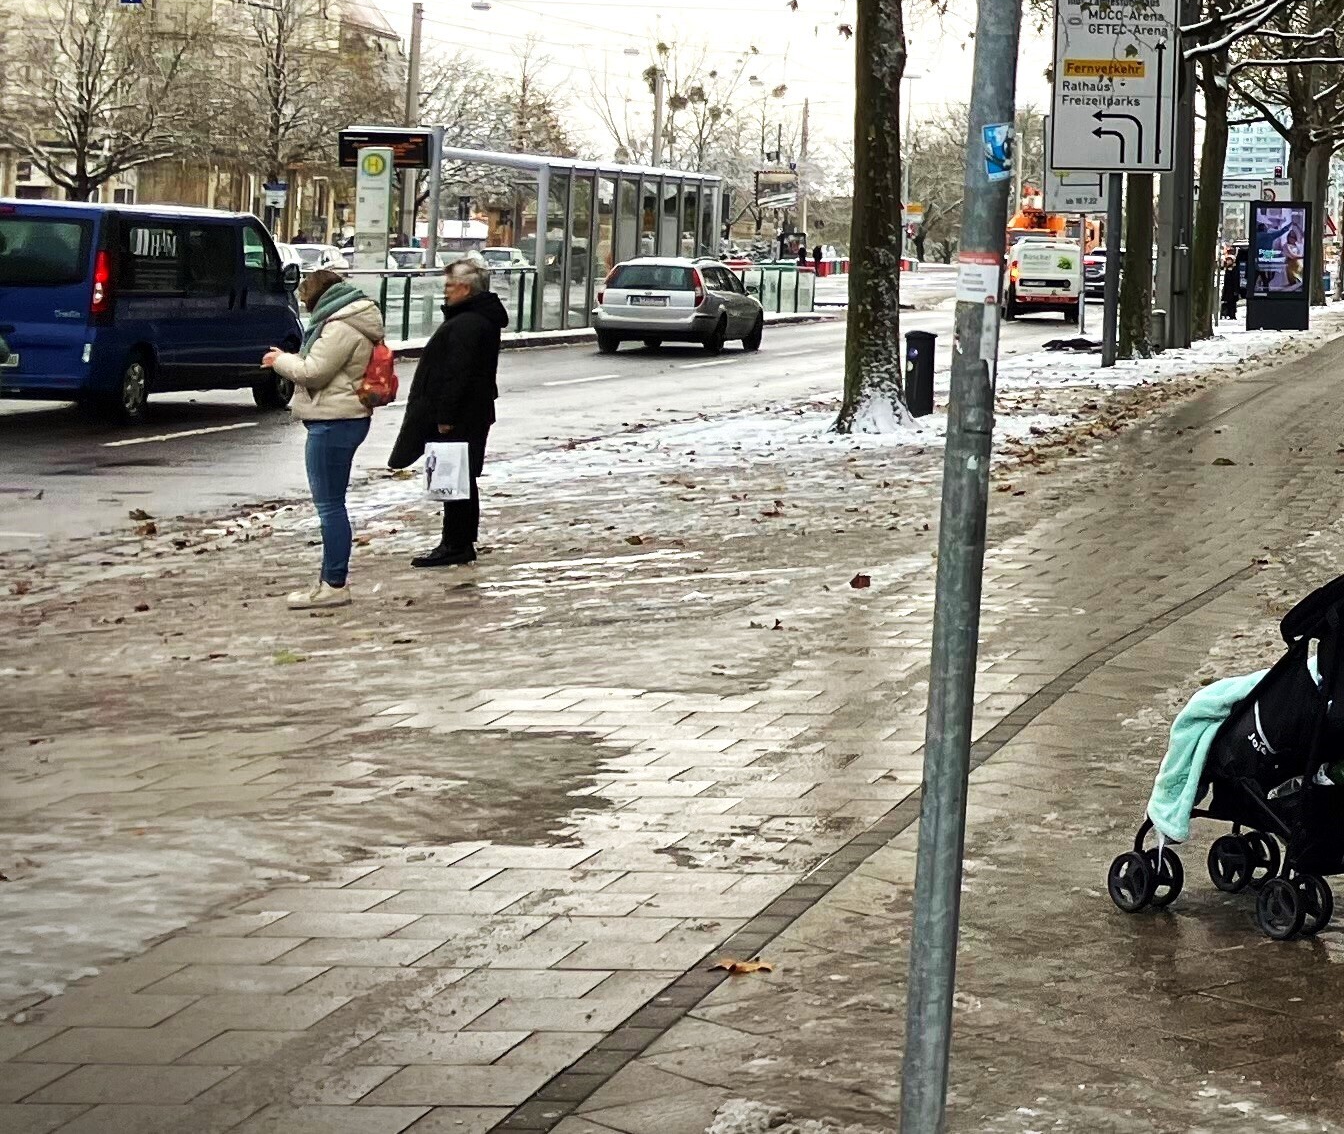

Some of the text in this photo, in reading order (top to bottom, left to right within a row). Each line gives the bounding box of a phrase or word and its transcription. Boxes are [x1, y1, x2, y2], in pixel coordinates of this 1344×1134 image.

[1088, 24, 1169, 36] GETEC-Arena
[1066, 62, 1142, 75] Fernverkehr
[1062, 80, 1111, 92] Rathaus
[1062, 95, 1141, 109] Freizeitparks
